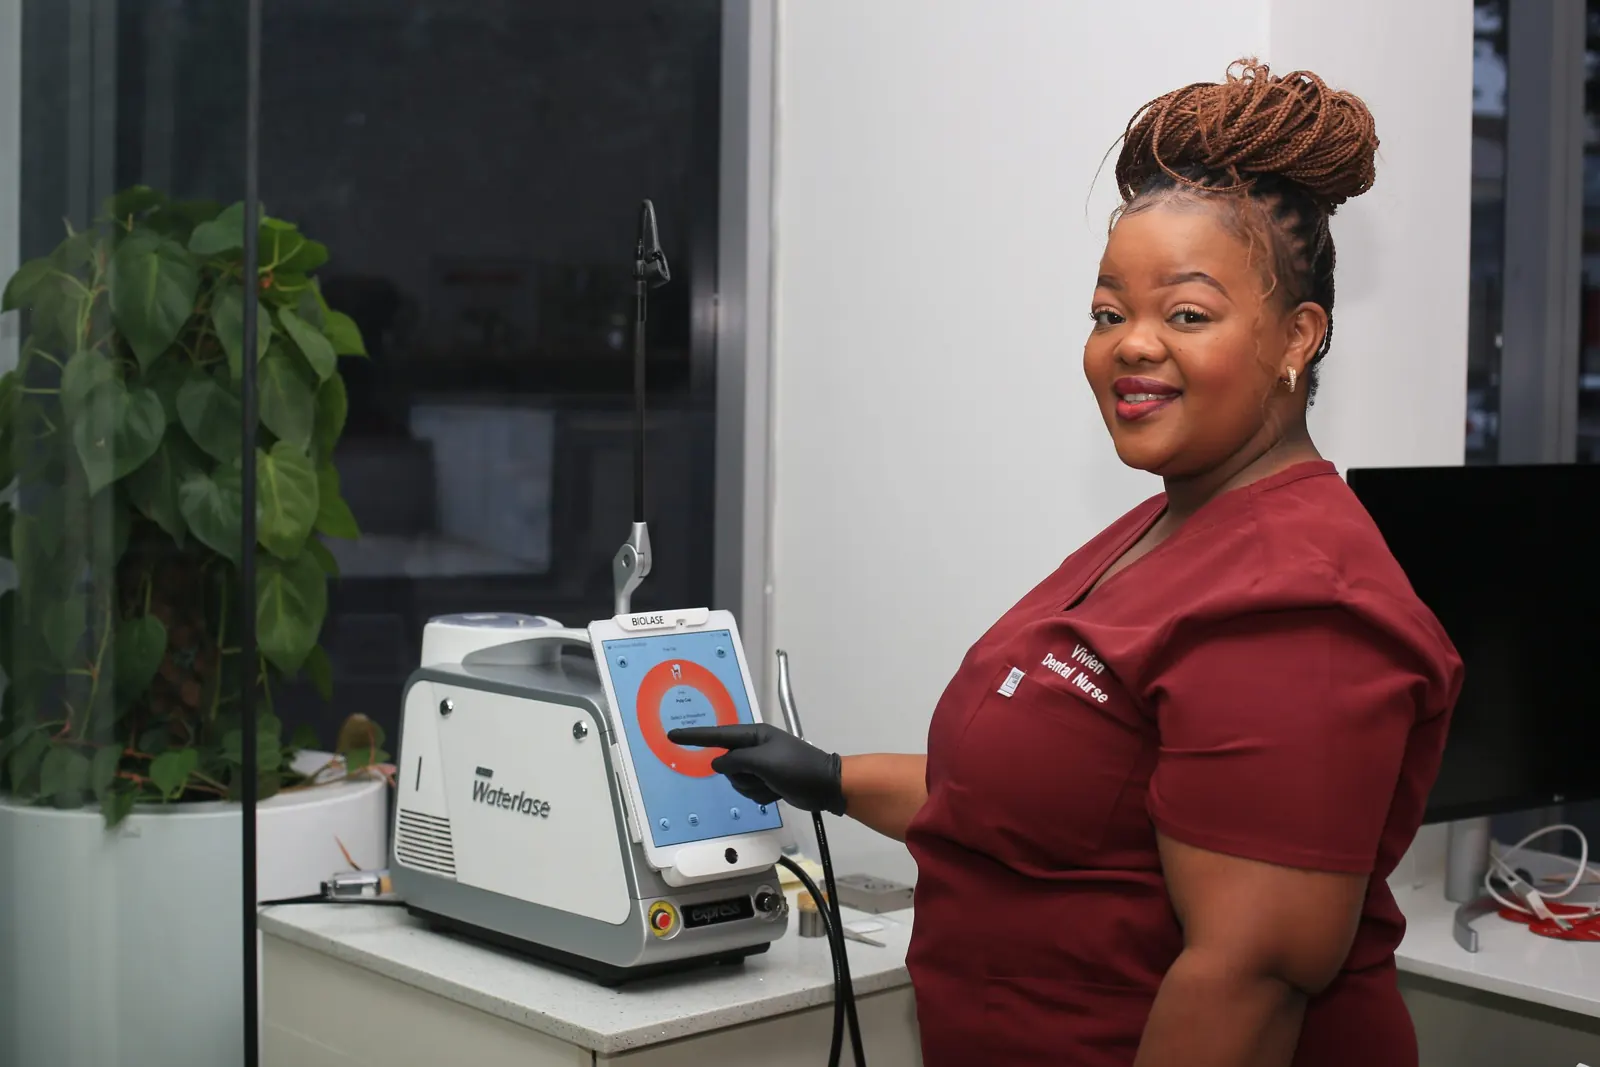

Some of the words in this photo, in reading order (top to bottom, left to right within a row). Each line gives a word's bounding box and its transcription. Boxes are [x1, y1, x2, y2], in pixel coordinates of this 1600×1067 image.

[632, 616, 664, 626] BIOLASE
[1071, 644, 1105, 675] Vivien
[1041, 652, 1076, 679] Dental
[1072, 672, 1109, 704] Nurse
[472, 780, 551, 819] Waterlase
